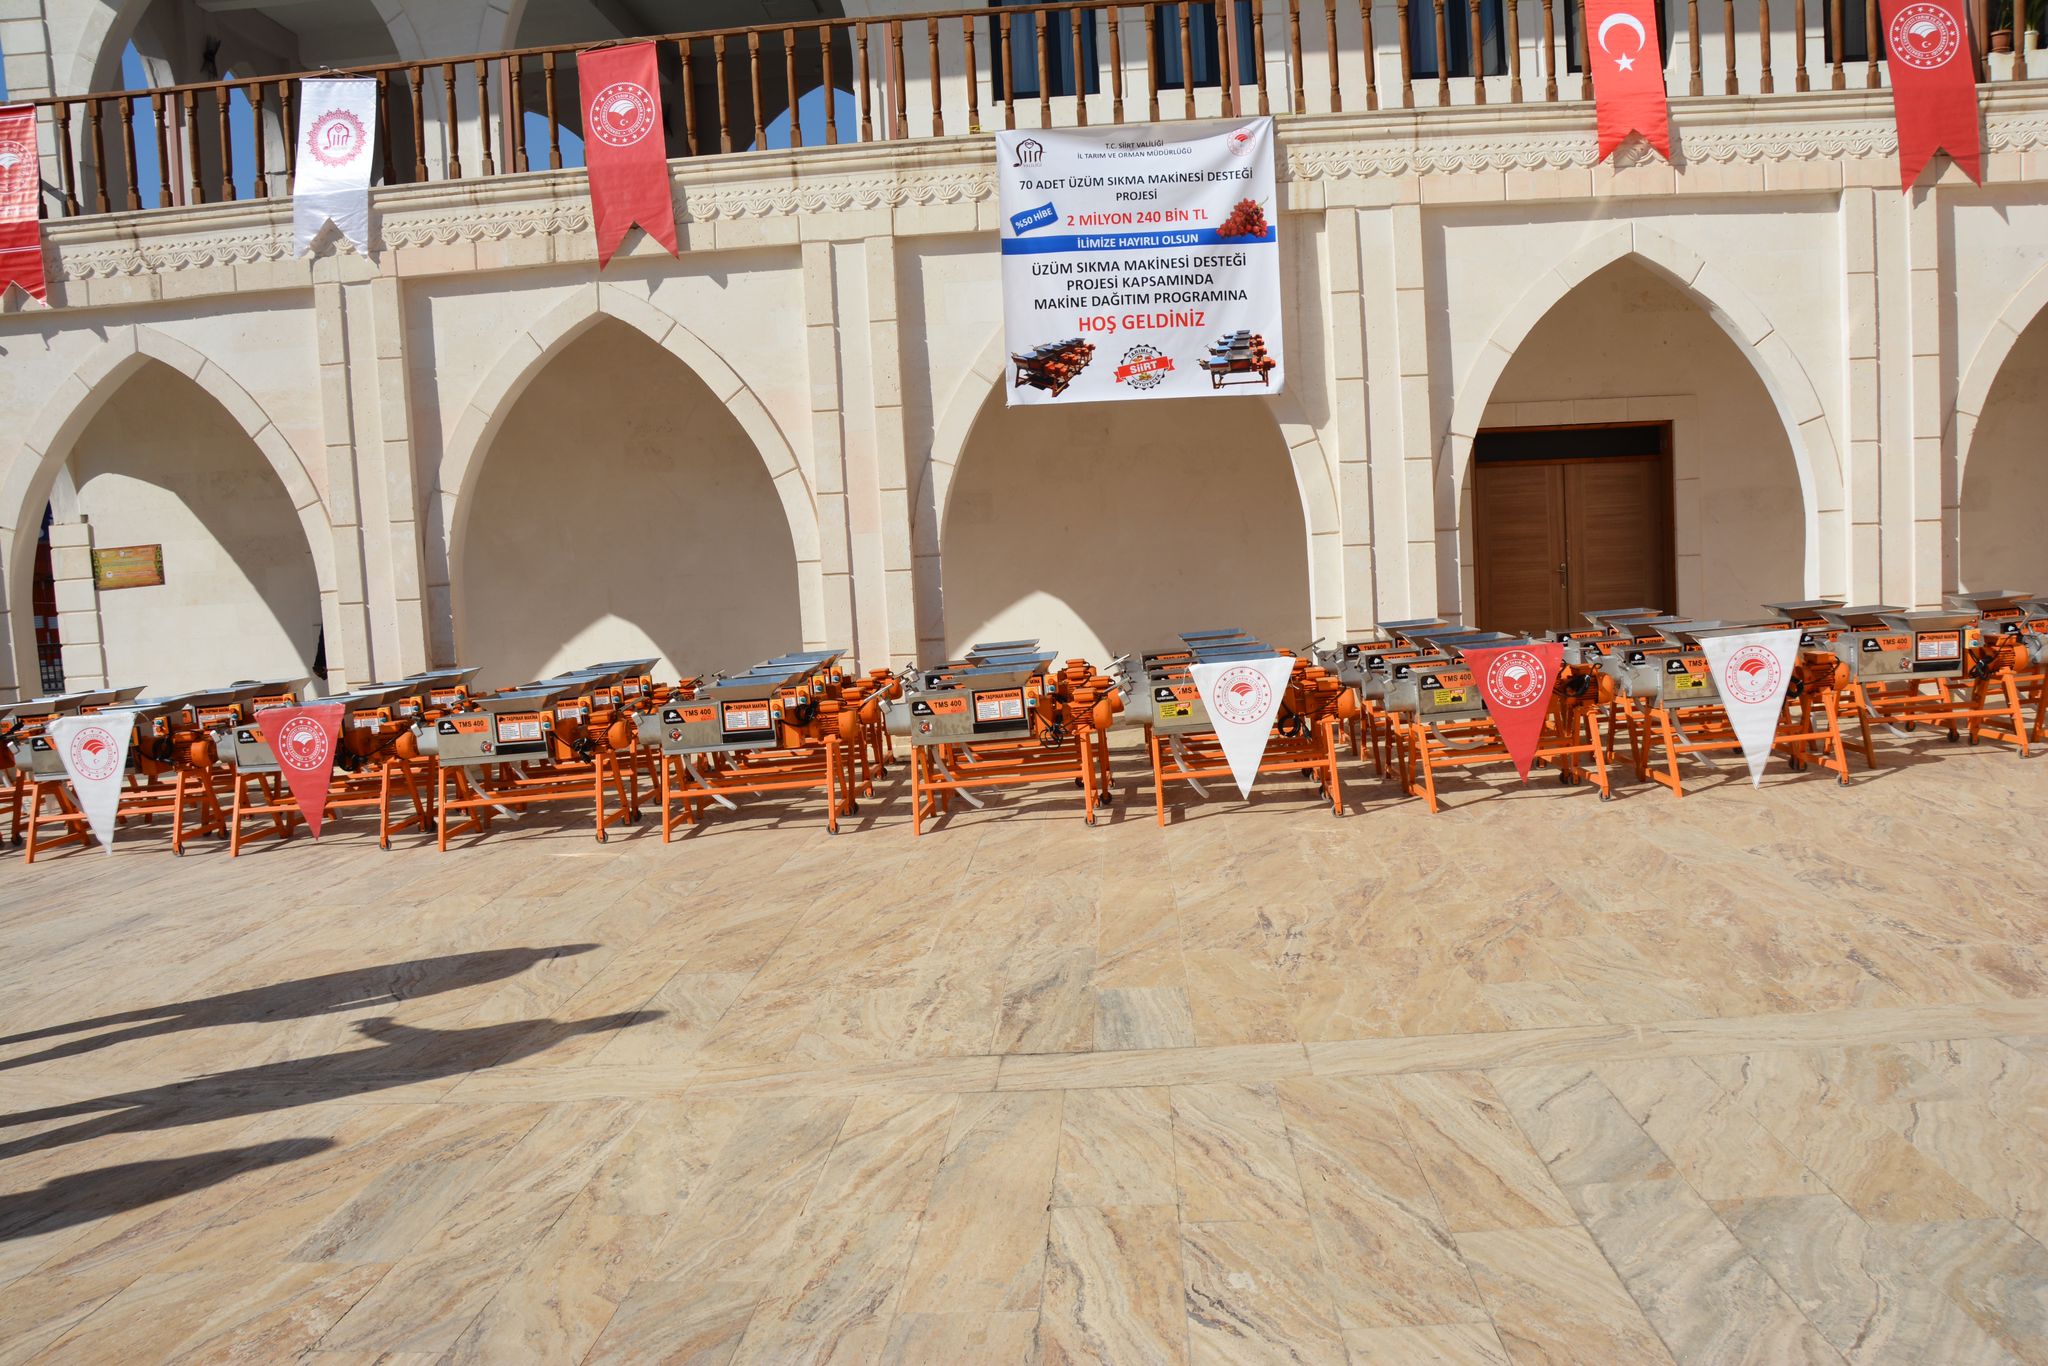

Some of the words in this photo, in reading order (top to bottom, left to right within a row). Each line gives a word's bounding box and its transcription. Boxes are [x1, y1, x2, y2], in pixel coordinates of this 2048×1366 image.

[1136, 140, 1164, 148] VALİLİĞİ
[1146, 147, 1192, 157] MÜDÜRLÜĞÜ
[1020, 180, 1033, 190] 70
[1036, 178, 1065, 190] ADET
[1068, 175, 1104, 188] ÜZÜM
[1108, 174, 1144, 186] SIKMA
[1148, 170, 1204, 185] MAKİNESİ
[1207, 168, 1253, 182] DESTEĞİ
[1116, 188, 1157, 202] PROJESİ
[1015, 215, 1033, 229] %50
[1034, 207, 1053, 222] HİBE
[1067, 215, 1075, 227] 2
[1079, 210, 1132, 226] MİLYON
[1136, 212, 1161, 224] 240
[1165, 208, 1189, 222] BİN
[1192, 208, 1208, 221] TL
[1077, 236, 1116, 249] İLİMİZE
[1118, 236, 1159, 248] HAYIRLI
[1162, 234, 1199, 246] OLSUN
[1032, 262, 1073, 276] ÜZÜM
[1076, 262, 1120, 274] SIKMA
[1124, 257, 1189, 272] MAKİNESİ
[1193, 252, 1246, 268] DESTEĞİ
[1066, 276, 1118, 292] PROJESİ
[1122, 274, 1214, 289] KAPSAMINDA
[1034, 294, 1088, 310] MAKİNE
[1092, 290, 1150, 308] DAĞITIM
[1154, 289, 1248, 305] PROGRAMINA
[1078, 315, 1117, 334] HOŞ
[1122, 308, 1206, 330] GELDİNİZ
[1128, 348, 1154, 359] TARIMLA
[1882, 638, 1896, 646] TMS
[1177, 686, 1192, 694] TMS
[700, 708, 712, 716] 400
